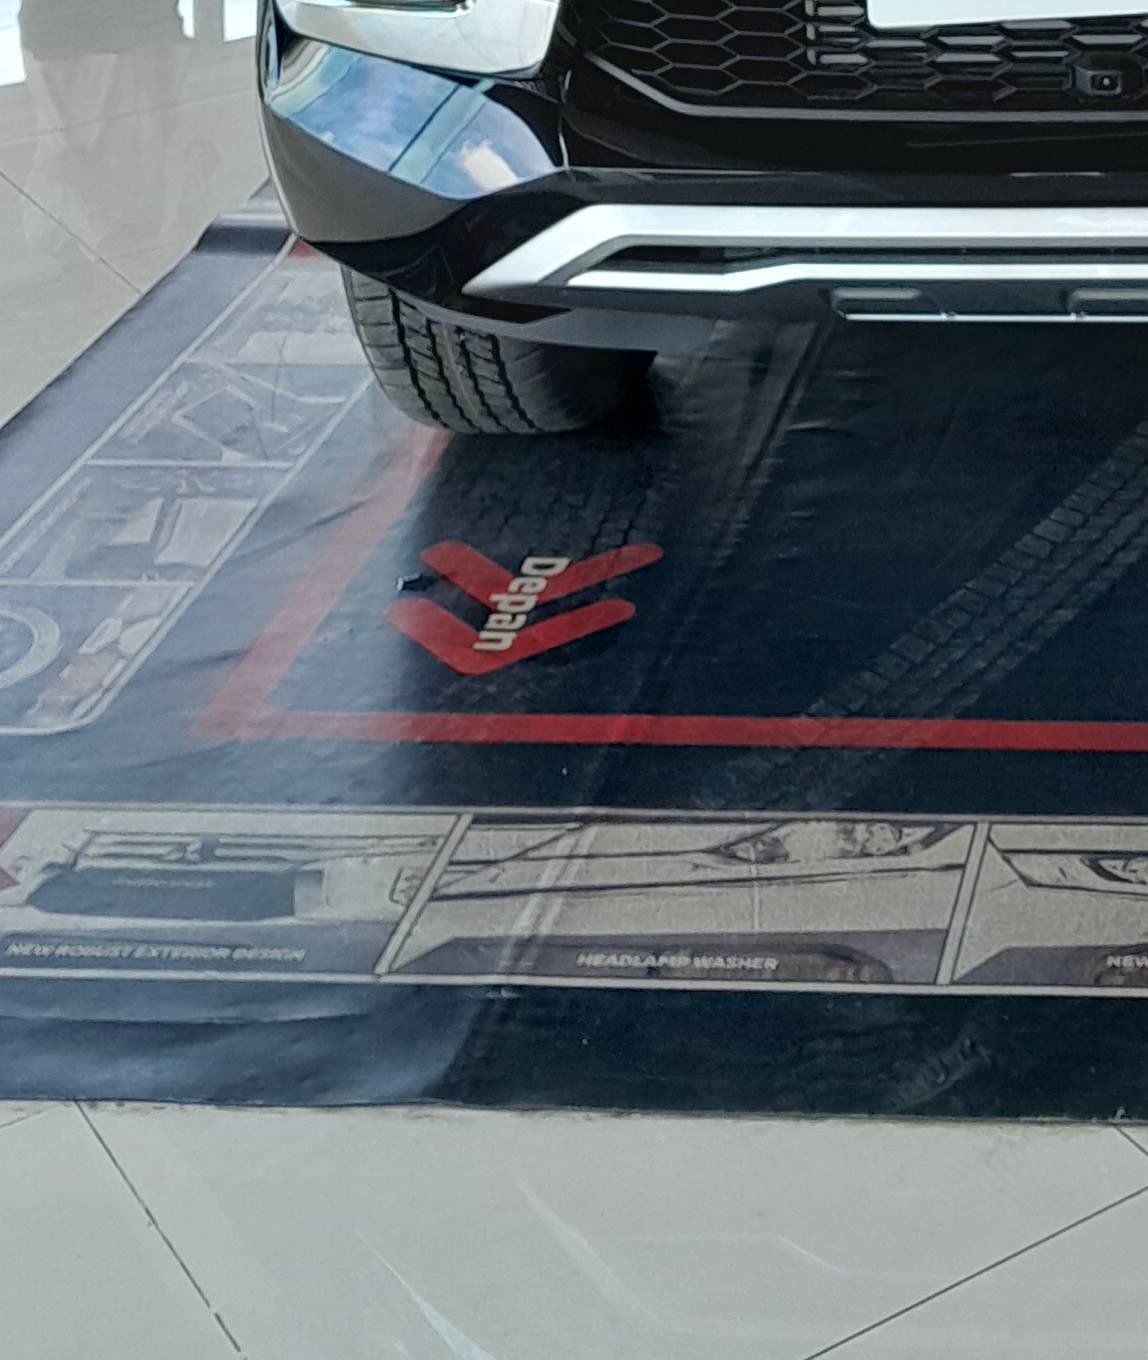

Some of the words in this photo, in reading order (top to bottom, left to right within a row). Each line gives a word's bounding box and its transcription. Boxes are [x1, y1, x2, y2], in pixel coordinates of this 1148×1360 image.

[472, 556, 572, 651] Depan
[576, 952, 692, 969] HEADLAMP
[693, 954, 780, 971] WASHER
